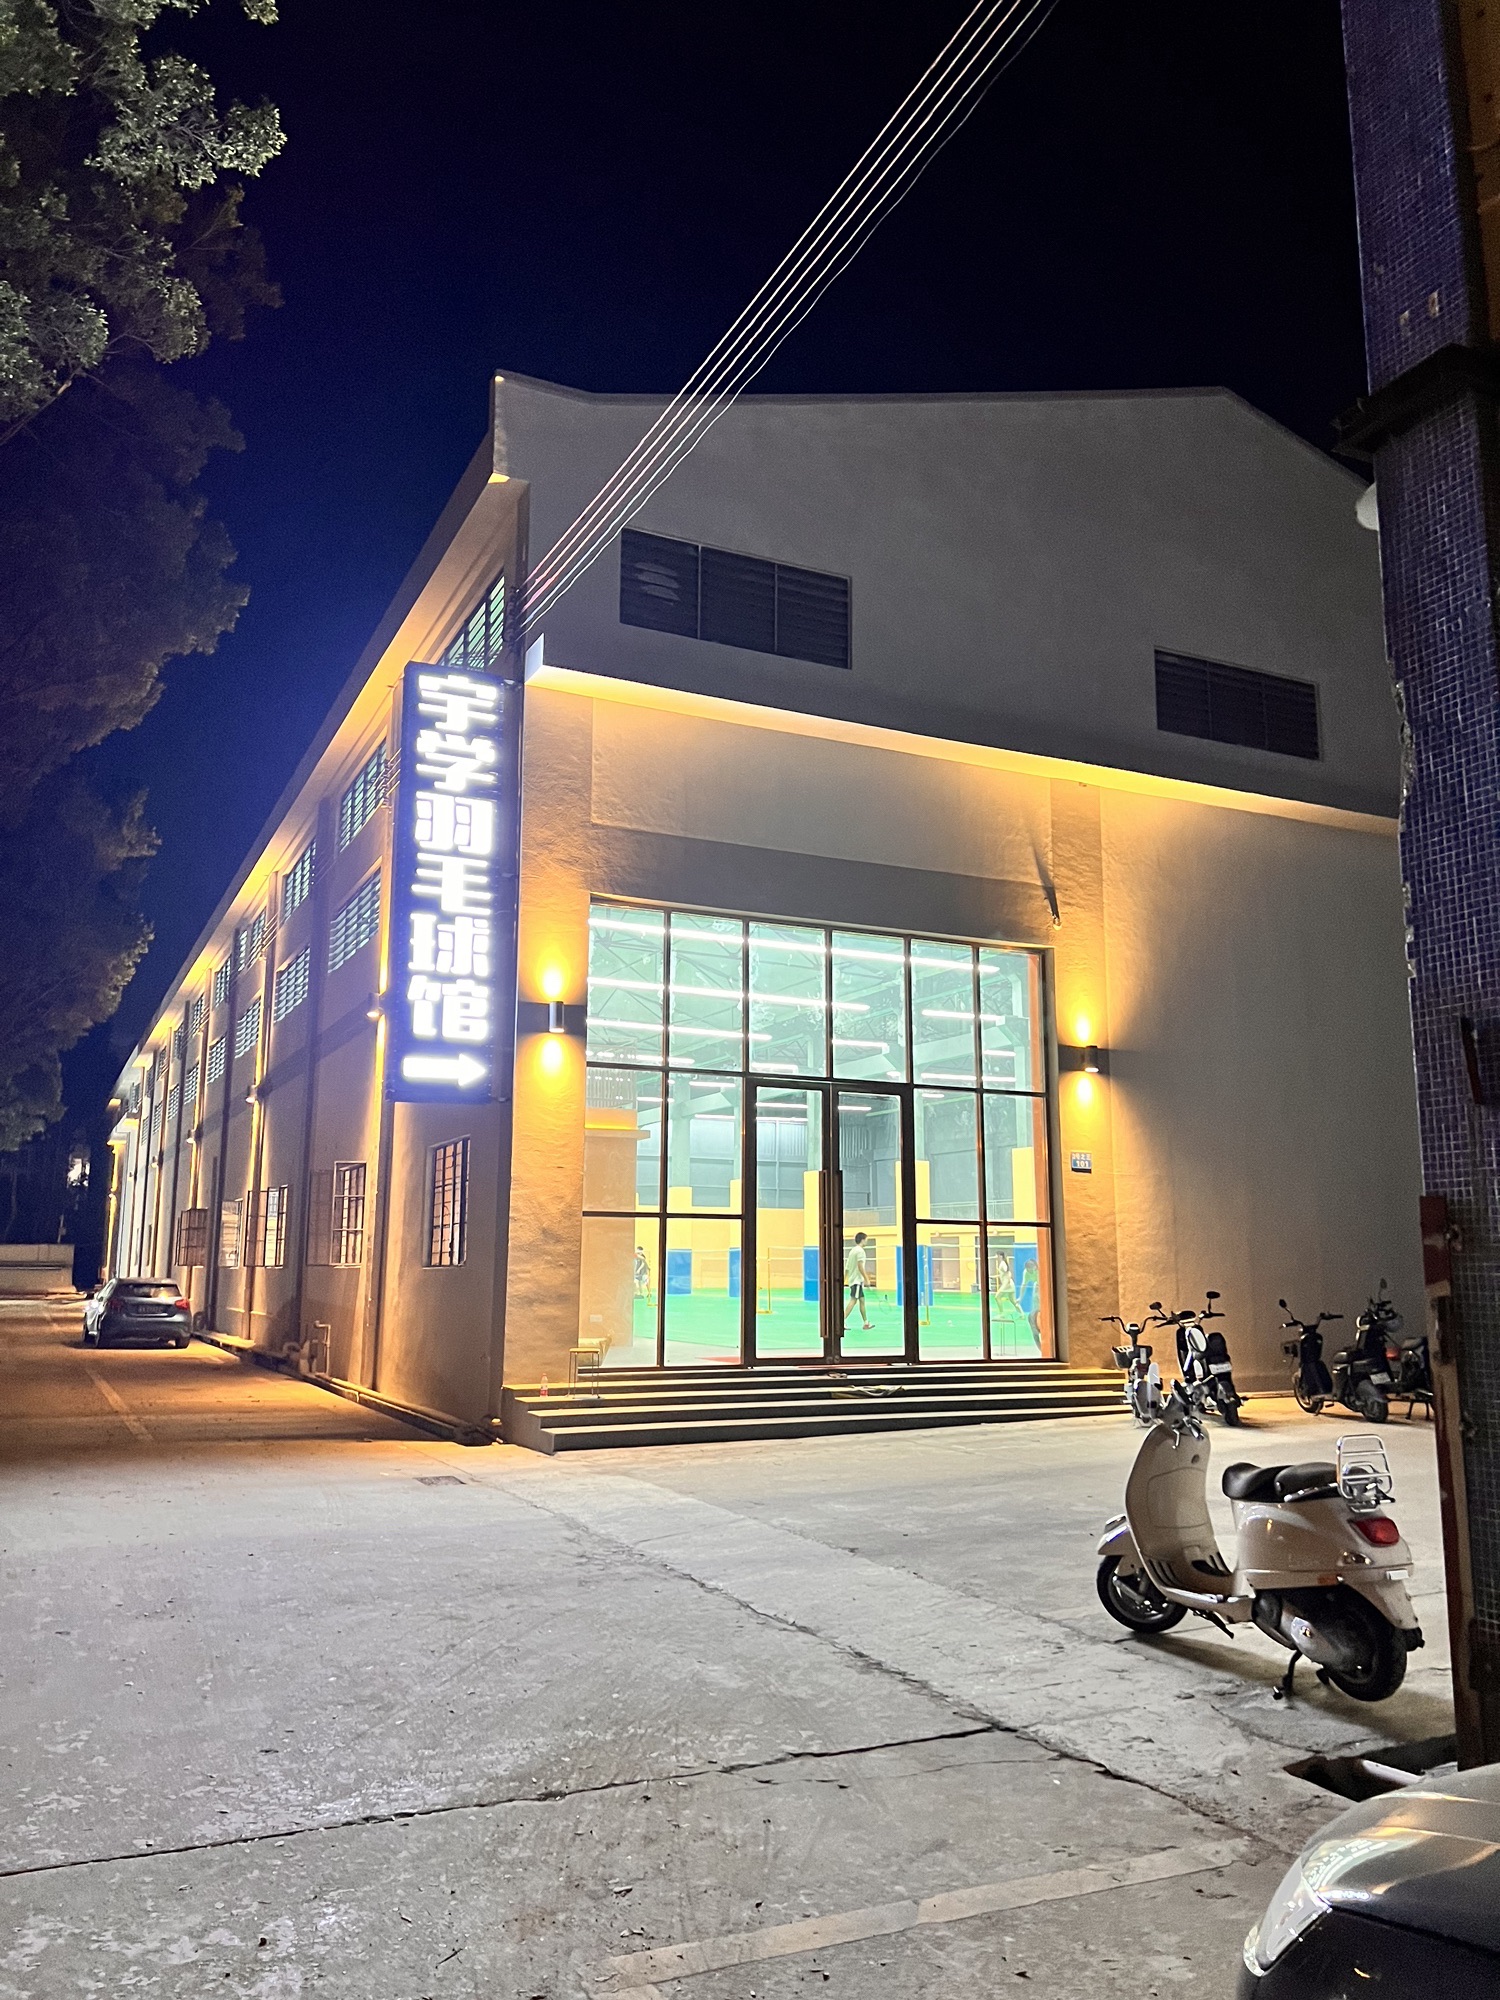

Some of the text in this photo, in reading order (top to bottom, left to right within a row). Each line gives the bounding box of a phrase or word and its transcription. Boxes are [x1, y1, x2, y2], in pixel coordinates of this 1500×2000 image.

[408, 674, 498, 1041] 宇学羽毛球馆
[1076, 1160, 1089, 1168] 101
